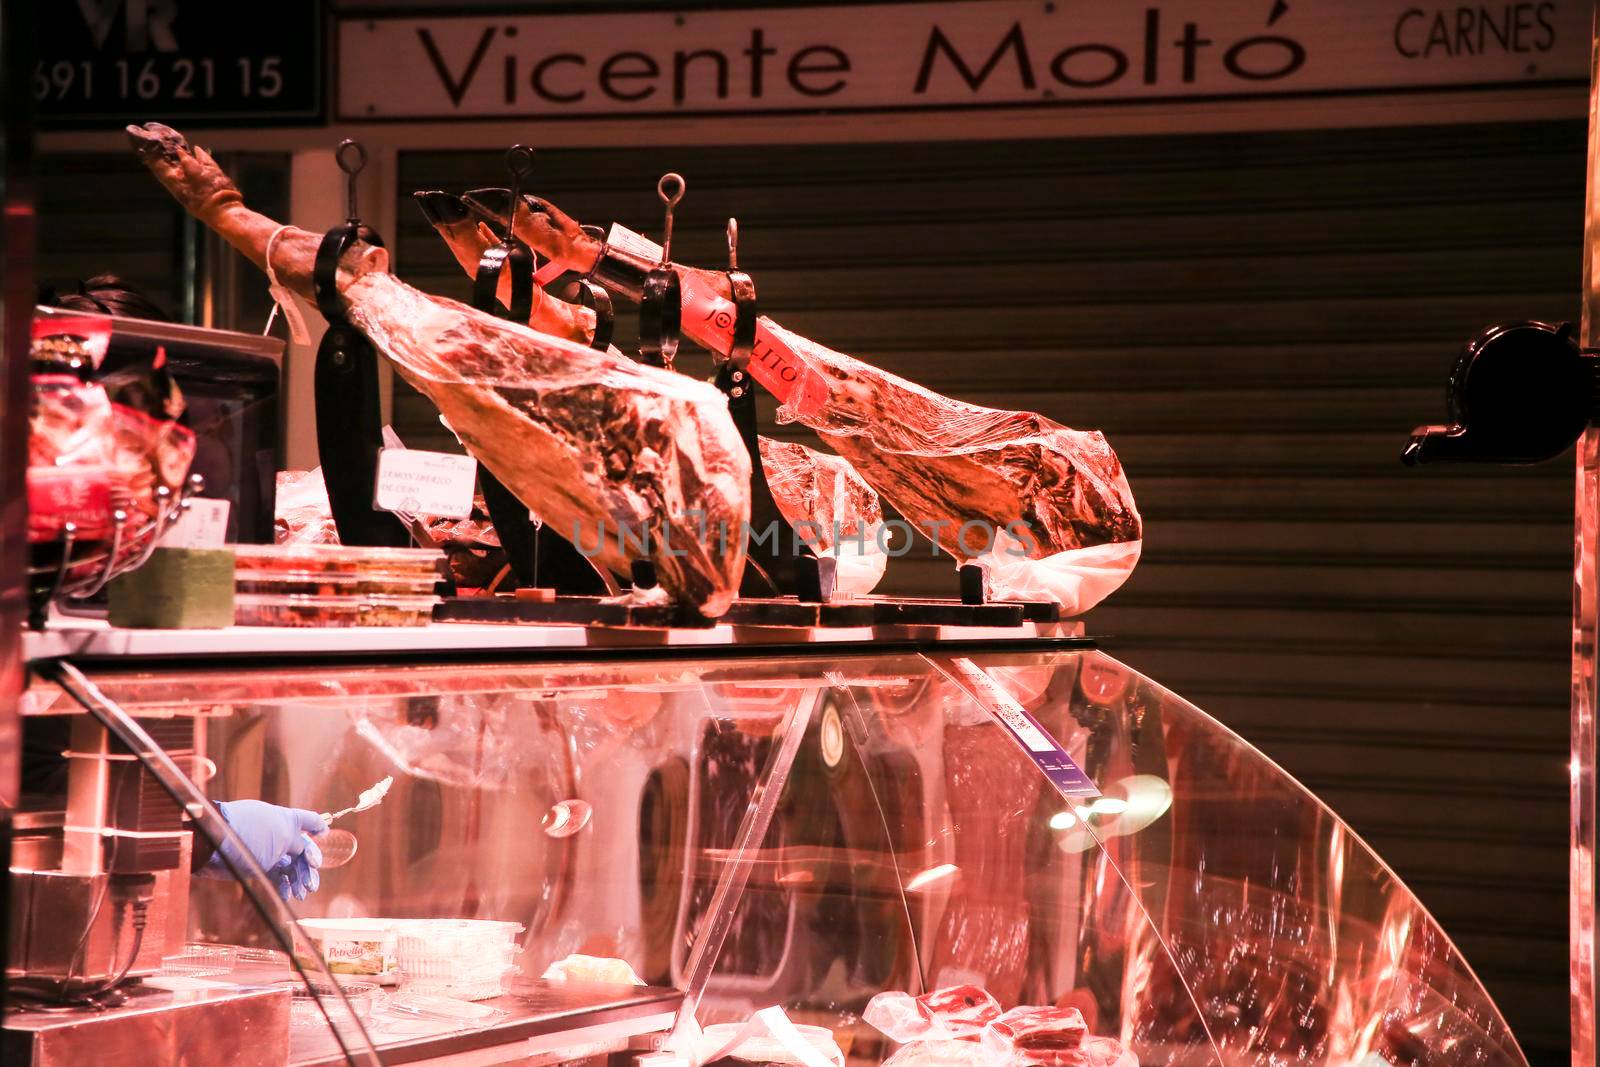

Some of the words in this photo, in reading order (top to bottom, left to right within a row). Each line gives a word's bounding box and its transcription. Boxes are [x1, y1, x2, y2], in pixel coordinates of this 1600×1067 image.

[416, 26, 852, 108] Vicente
[913, 0, 1306, 93] Moltó
[1394, 2, 1556, 58] CARNES
[32, 60, 93, 100] 691
[115, 59, 160, 99] 16
[172, 58, 216, 98] 21
[237, 56, 284, 98] 15
[329, 946, 364, 959] Petrella
